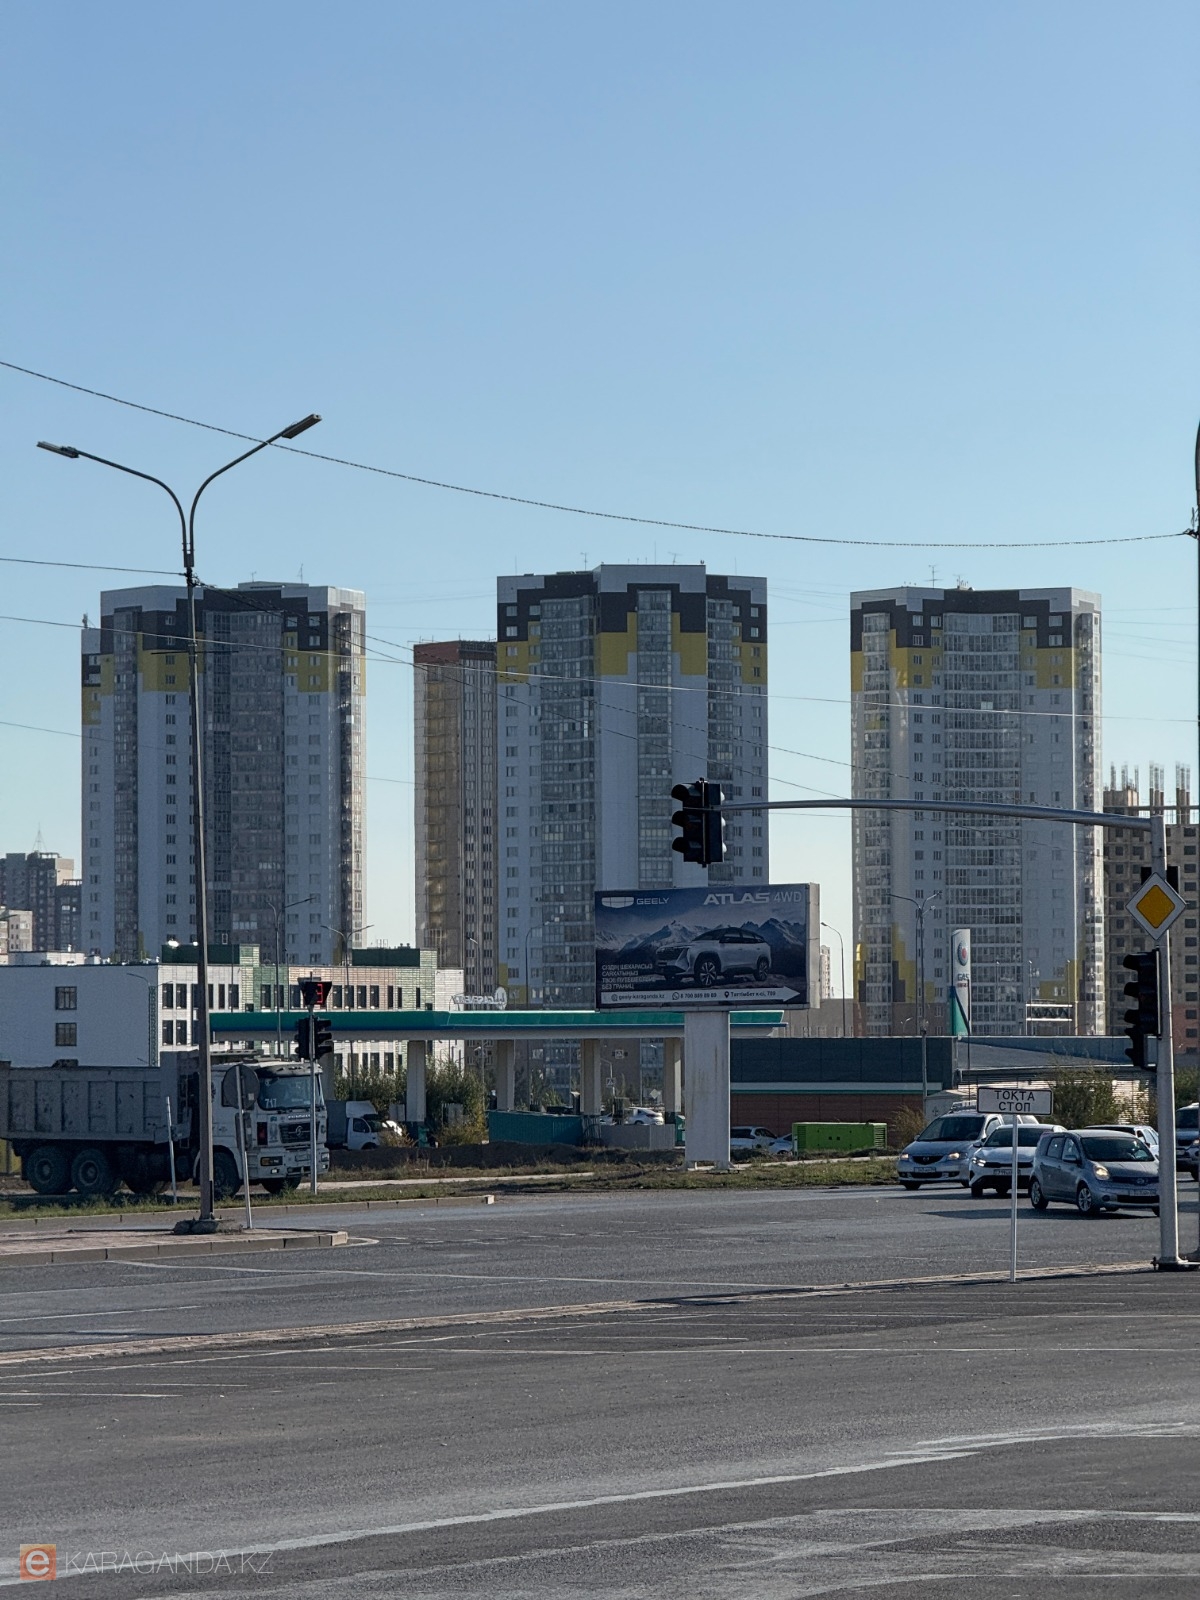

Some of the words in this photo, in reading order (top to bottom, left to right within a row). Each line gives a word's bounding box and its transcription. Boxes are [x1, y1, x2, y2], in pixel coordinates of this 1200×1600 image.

[636, 897, 670, 906] GEELY
[703, 892, 771, 906] ATLAS
[773, 891, 802, 904] 4WD
[995, 1090, 1036, 1103] ТОҚТА
[265, 1098, 277, 1108] 717
[998, 1101, 1031, 1111] СТОП
